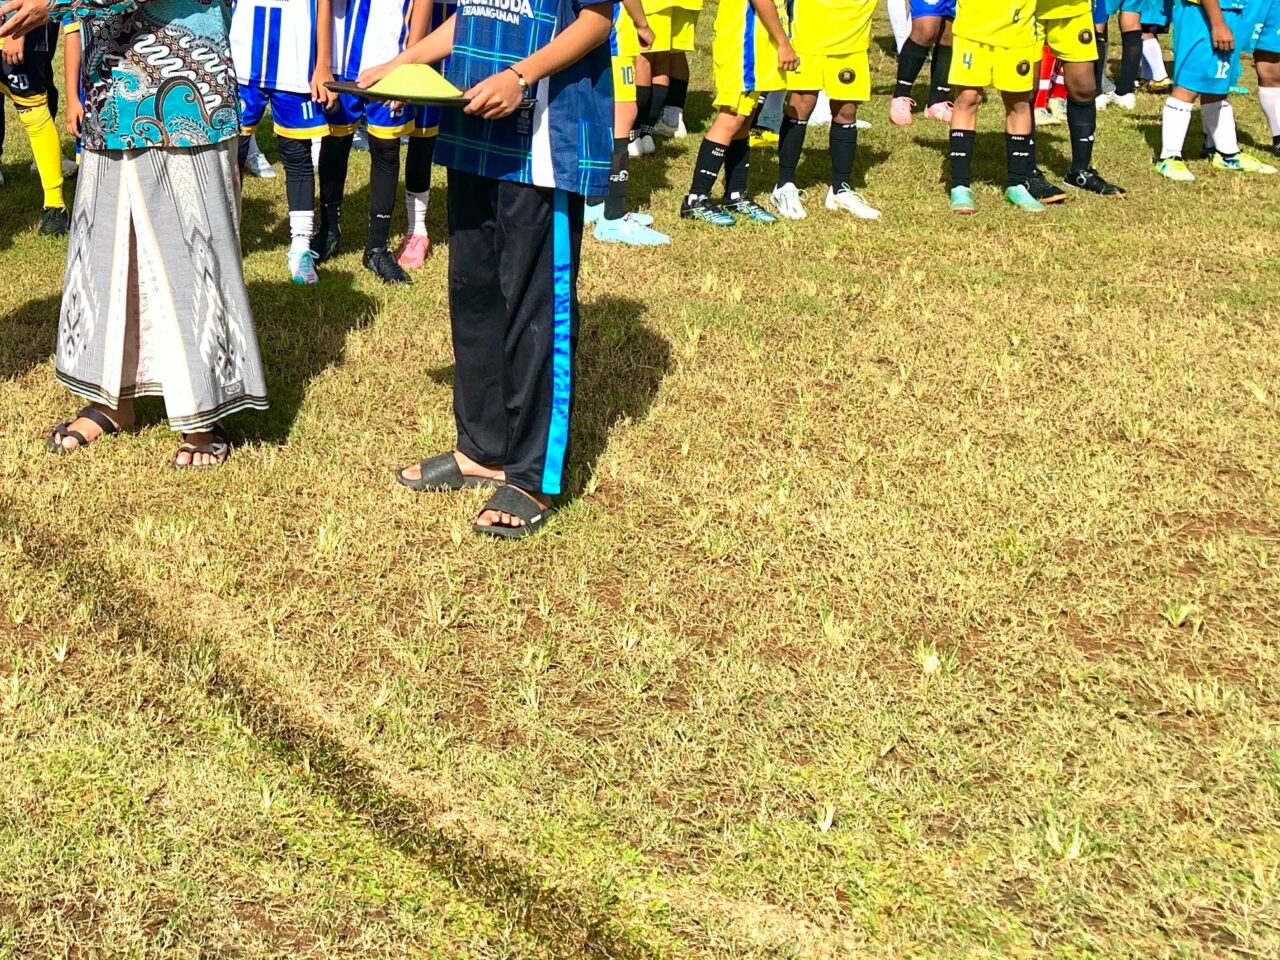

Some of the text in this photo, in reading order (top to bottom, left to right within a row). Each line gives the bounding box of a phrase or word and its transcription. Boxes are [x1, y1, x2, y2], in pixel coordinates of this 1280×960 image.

[963, 52, 973, 70] 4
[1215, 60, 1230, 79] 12
[7, 74, 30, 90] 20
[620, 66, 634, 85] 10
[300, 101, 314, 120] 11
